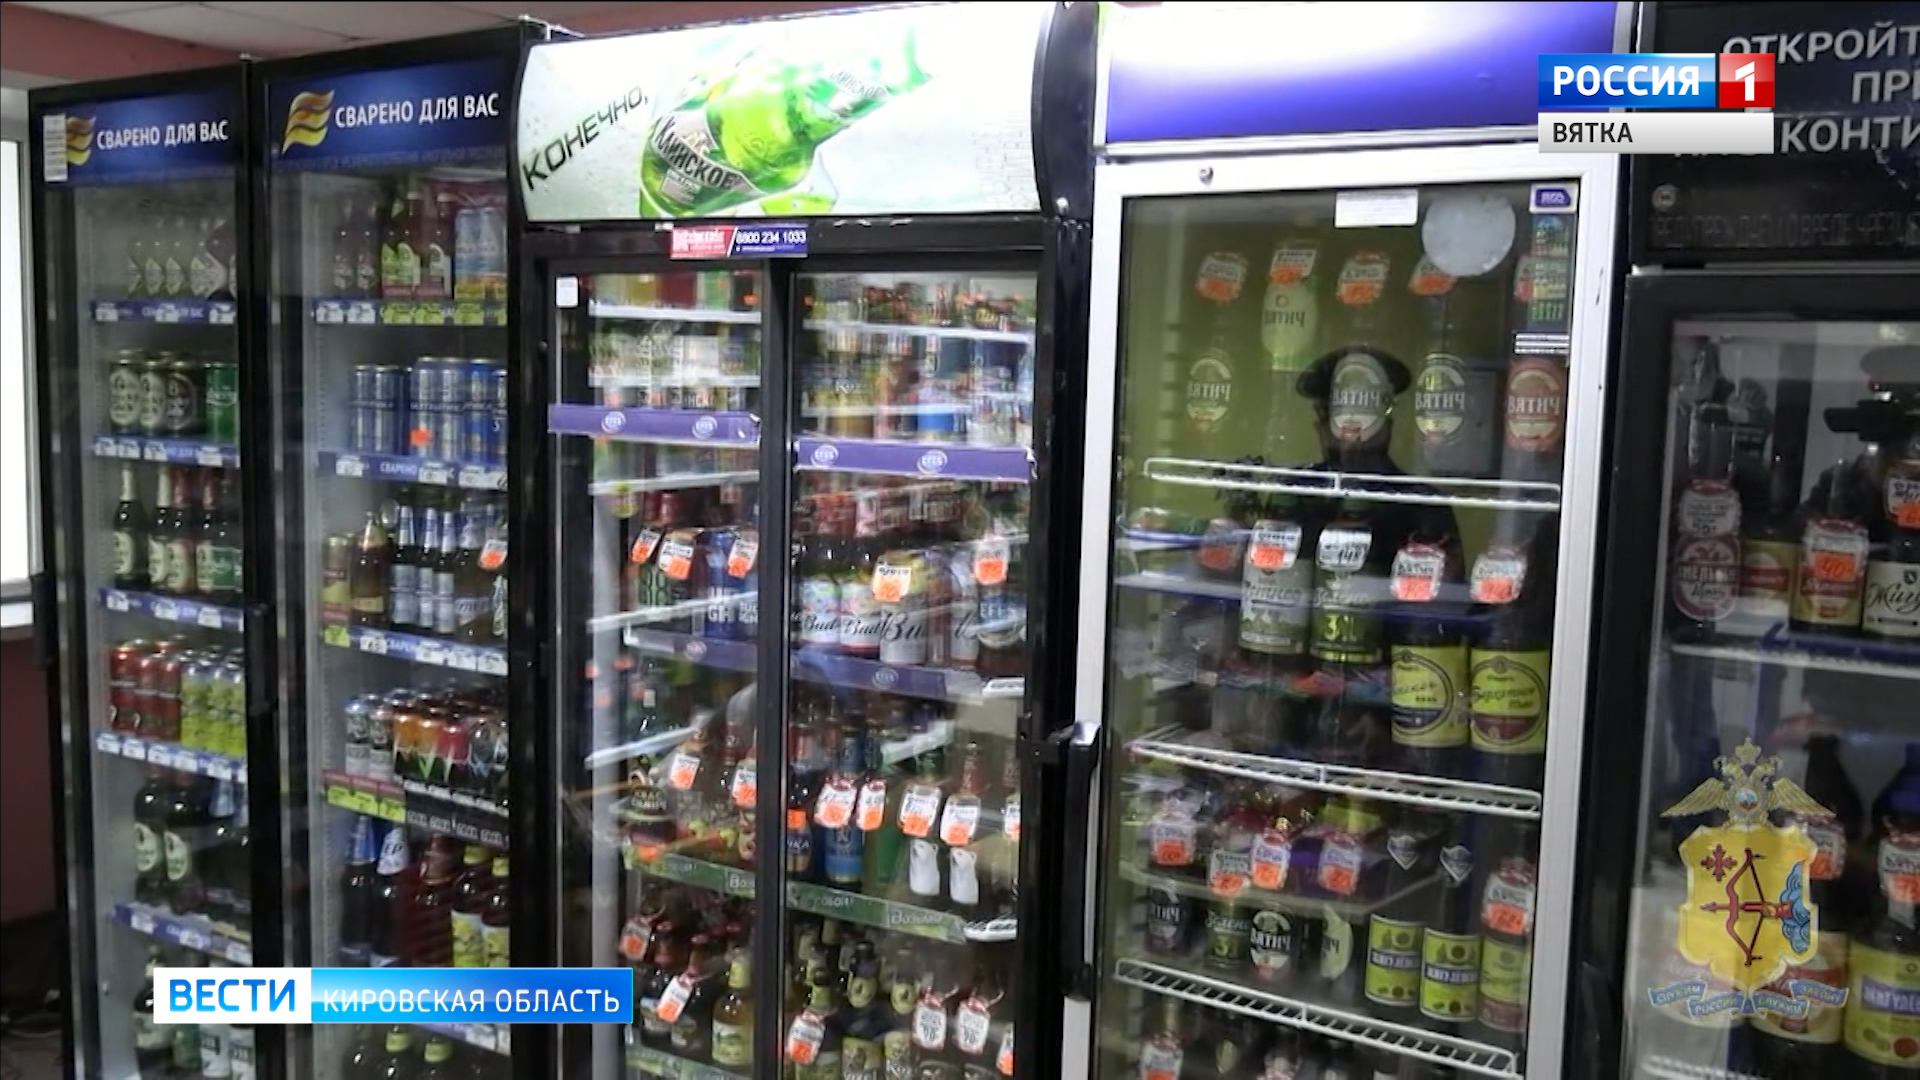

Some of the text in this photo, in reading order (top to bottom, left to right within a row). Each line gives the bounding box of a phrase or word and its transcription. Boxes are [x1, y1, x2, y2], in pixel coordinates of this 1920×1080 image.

[334, 92, 500, 129] СВАРЕНО ДЛЯ ВАС
[96, 119, 229, 150] СВАРЕНО ДЛЯ ВАС
[522, 85, 649, 192] КОНЕЧНО,
